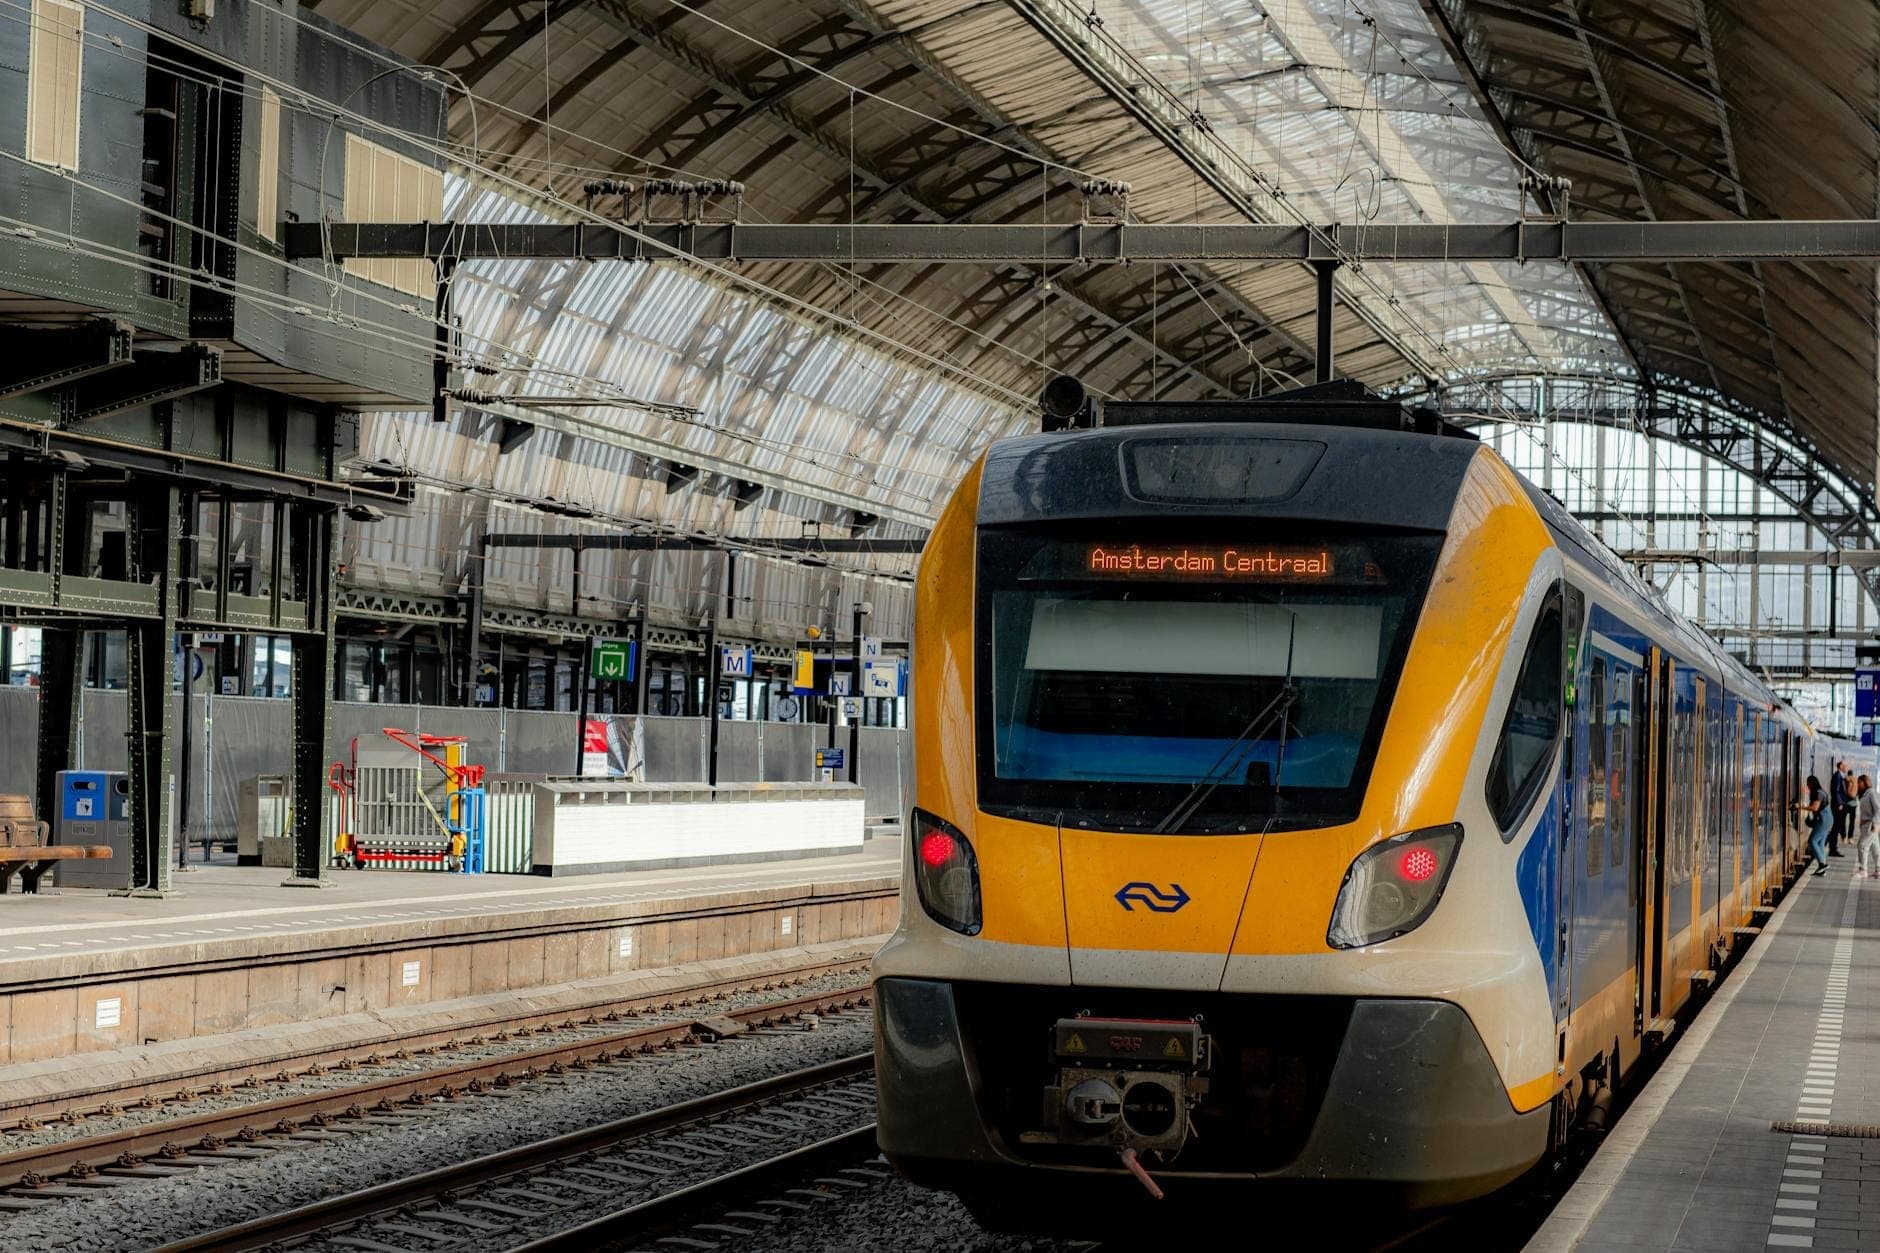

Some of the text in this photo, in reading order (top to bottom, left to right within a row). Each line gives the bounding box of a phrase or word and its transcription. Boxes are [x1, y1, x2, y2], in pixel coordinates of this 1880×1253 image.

[1092, 548, 1328, 573] Amsterdam Centraal
[867, 644, 876, 655] N
[727, 656, 743, 672] M
[834, 681, 844, 692] N
